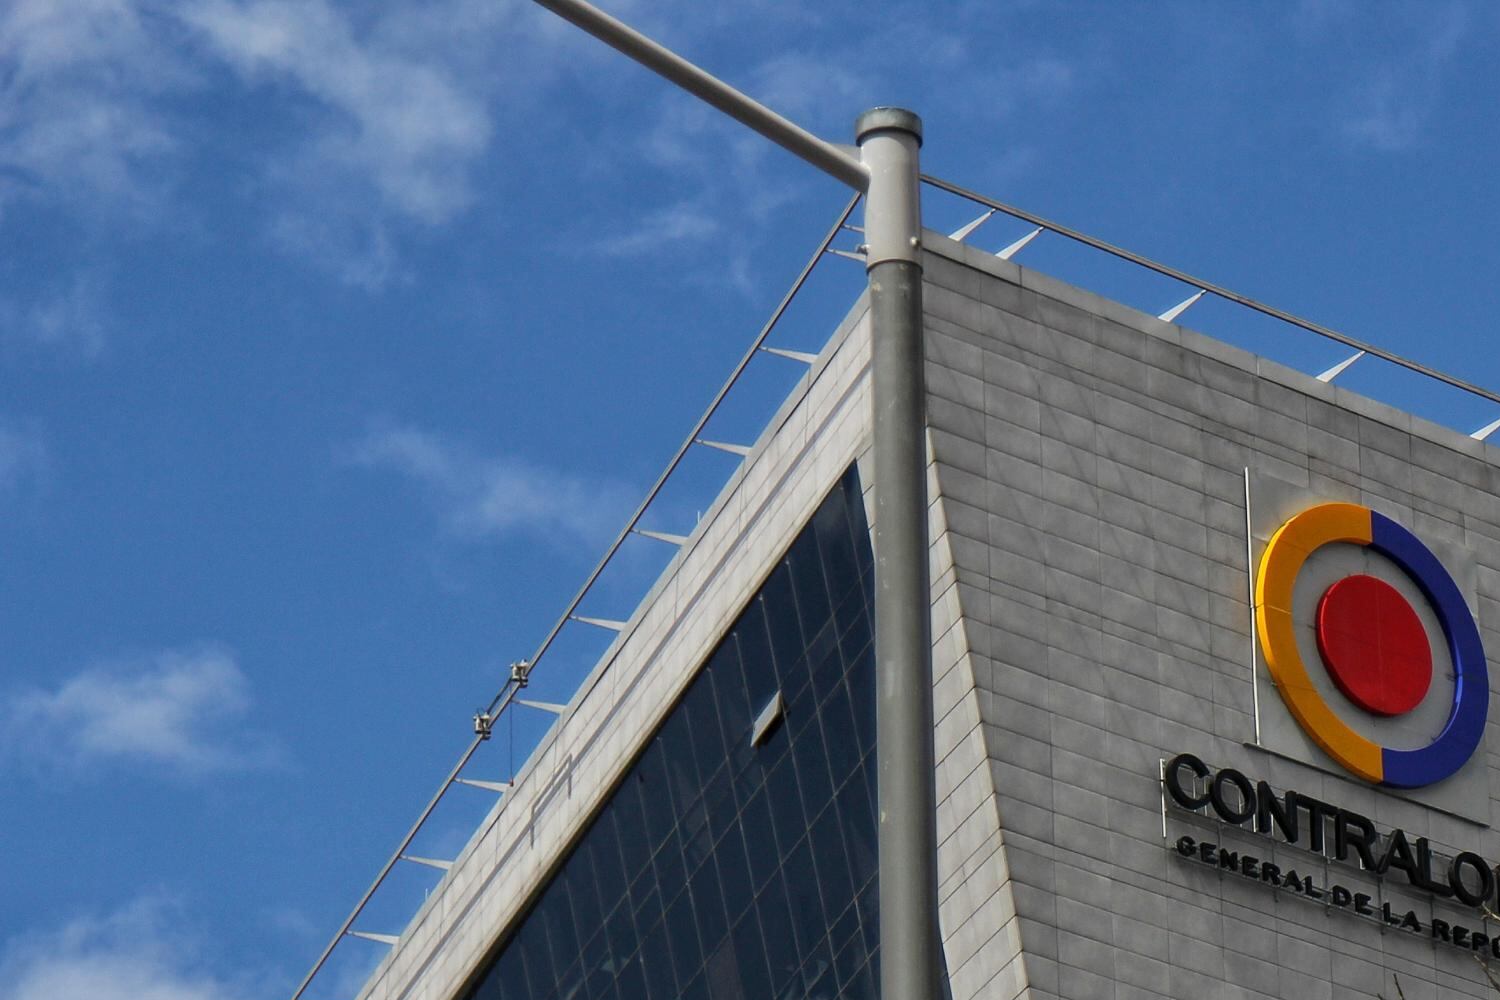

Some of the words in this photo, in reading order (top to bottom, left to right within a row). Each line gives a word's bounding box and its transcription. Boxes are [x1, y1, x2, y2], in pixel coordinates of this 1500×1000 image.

[1177, 836, 1322, 898] GENERAL
[1332, 885, 1372, 915] DE
[1383, 902, 1421, 932] LA
